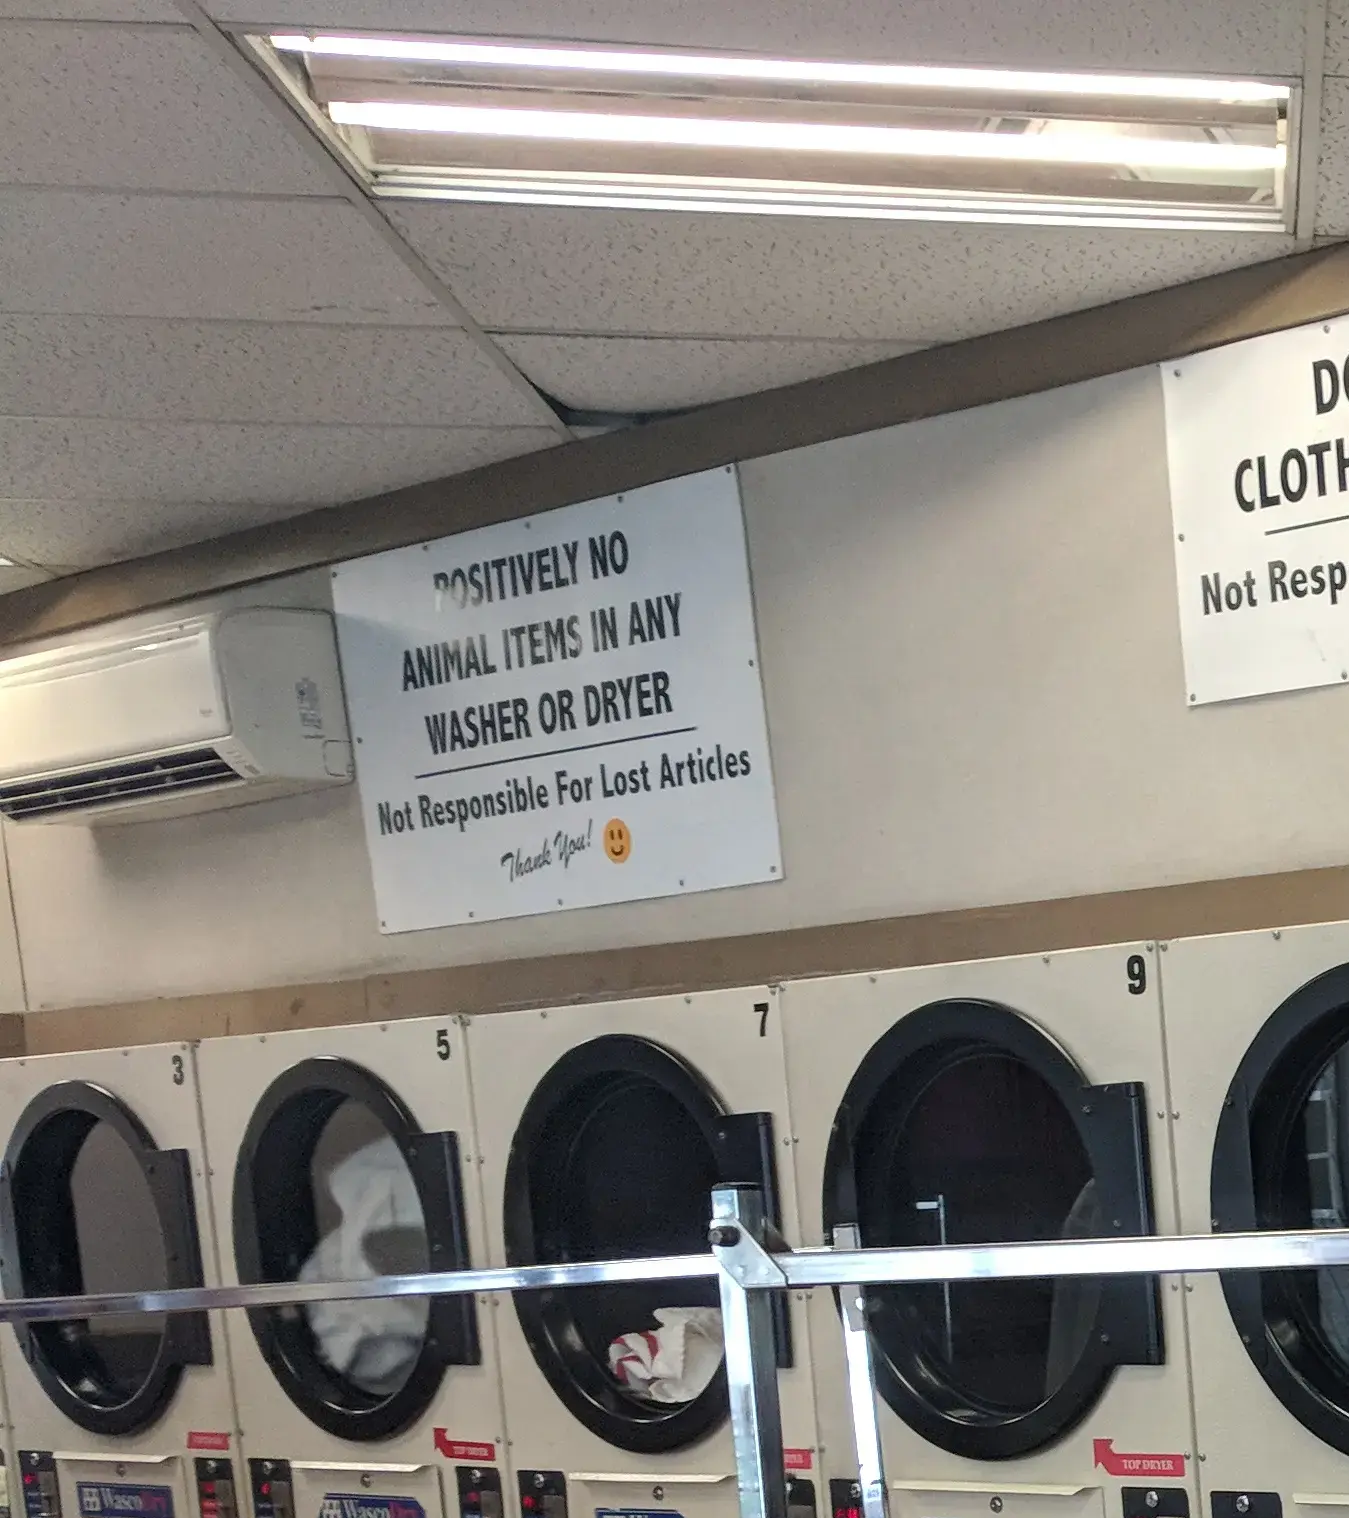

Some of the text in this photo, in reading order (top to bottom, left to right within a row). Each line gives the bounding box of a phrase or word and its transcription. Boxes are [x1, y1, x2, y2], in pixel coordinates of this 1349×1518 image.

[434, 530, 628, 608] POSITIVELY NO
[1200, 570, 1256, 615] Not
[402, 592, 682, 691] ANIMAL ITEMS IN ANY
[425, 671, 674, 755] WASHER OR DRYER
[378, 744, 752, 836] Not Responsible For Lost Articles
[501, 820, 592, 882] Thank You!
[1127, 955, 1146, 995] 9
[436, 1030, 450, 1060] 5
[753, 1003, 769, 1037] 7
[172, 1055, 184, 1086] 3
